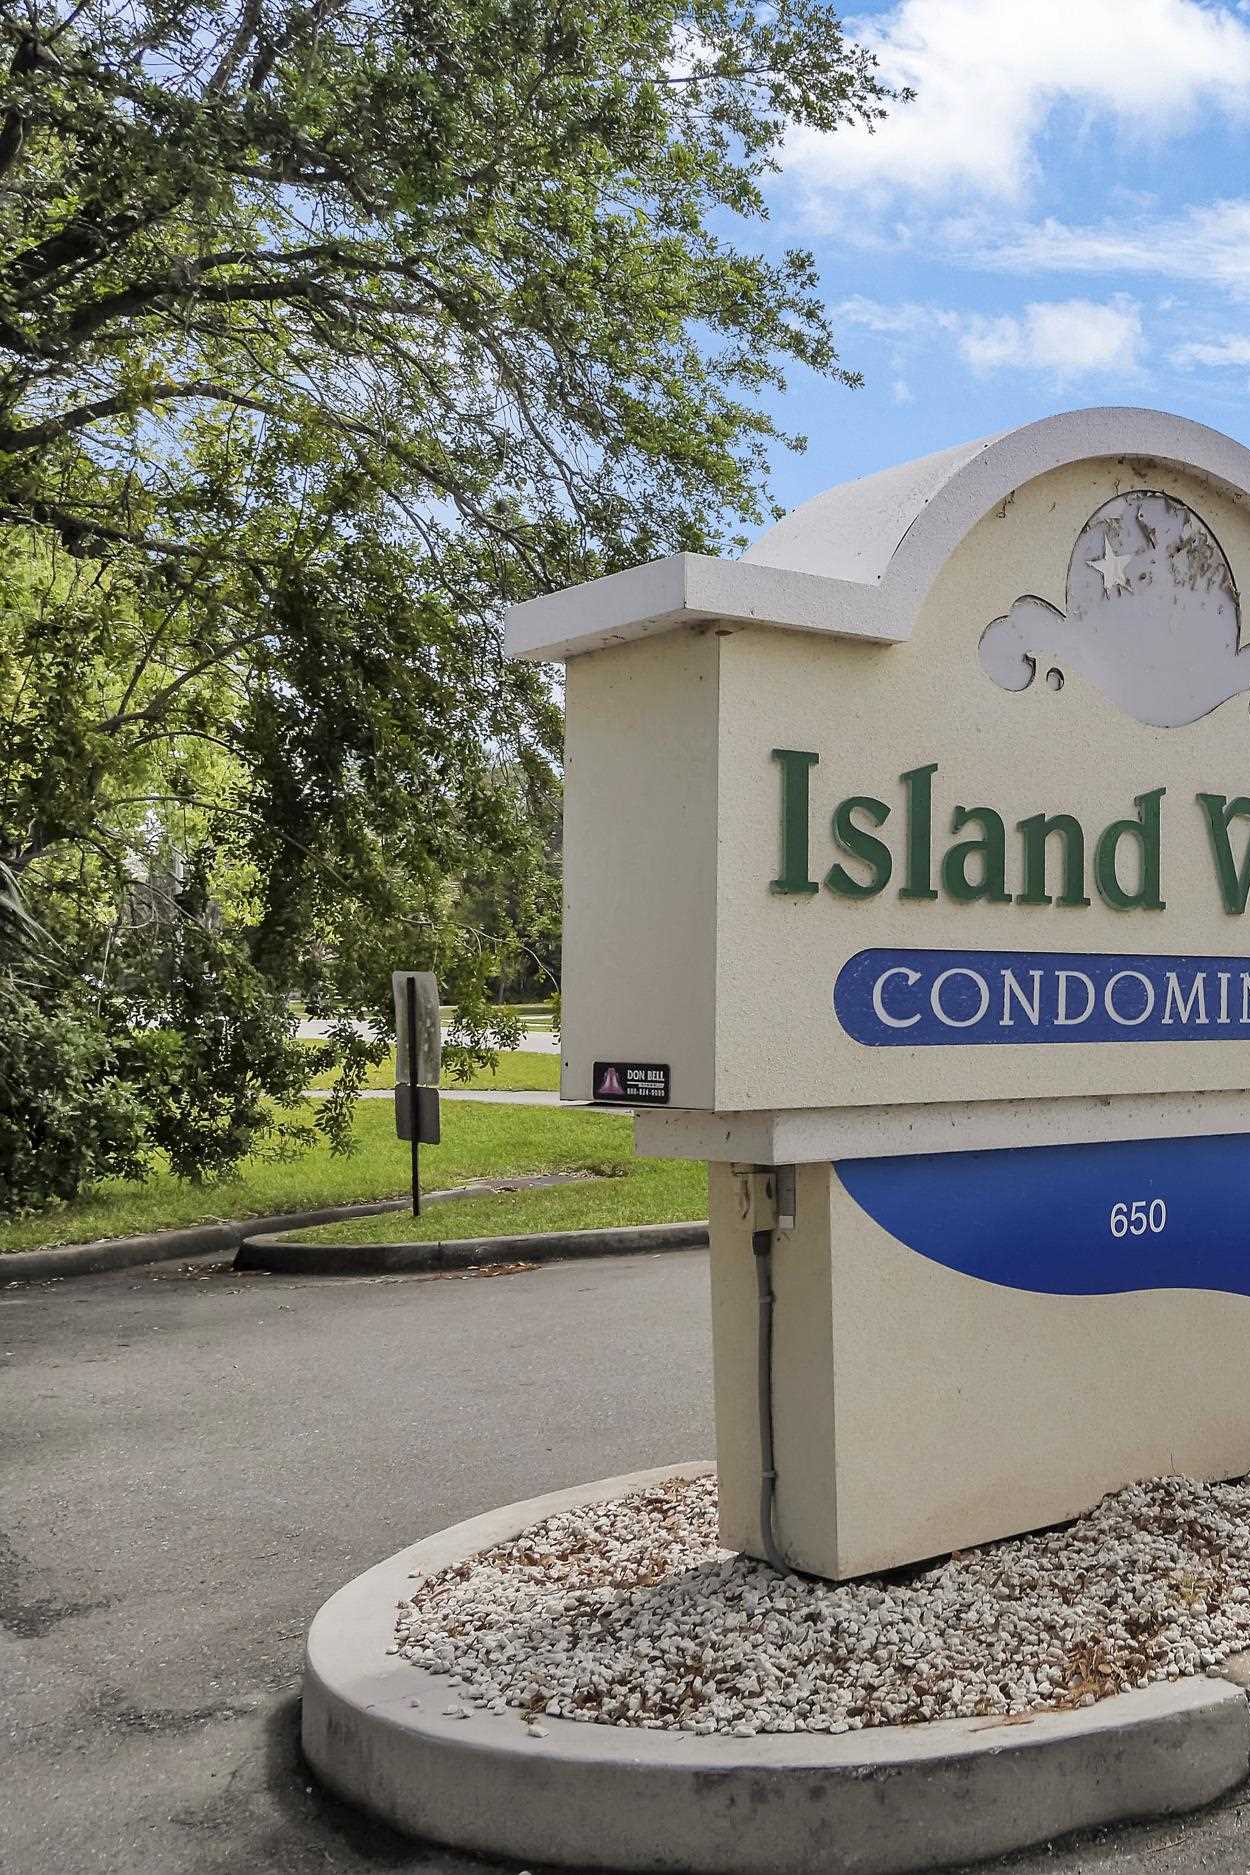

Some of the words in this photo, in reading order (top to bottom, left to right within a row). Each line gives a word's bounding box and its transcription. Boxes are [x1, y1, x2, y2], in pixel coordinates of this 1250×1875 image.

[770, 747, 1167, 912] Island
[627, 1069, 645, 1080] DON
[647, 1070, 665, 1081] BELL
[1110, 1199, 1167, 1237] 650
